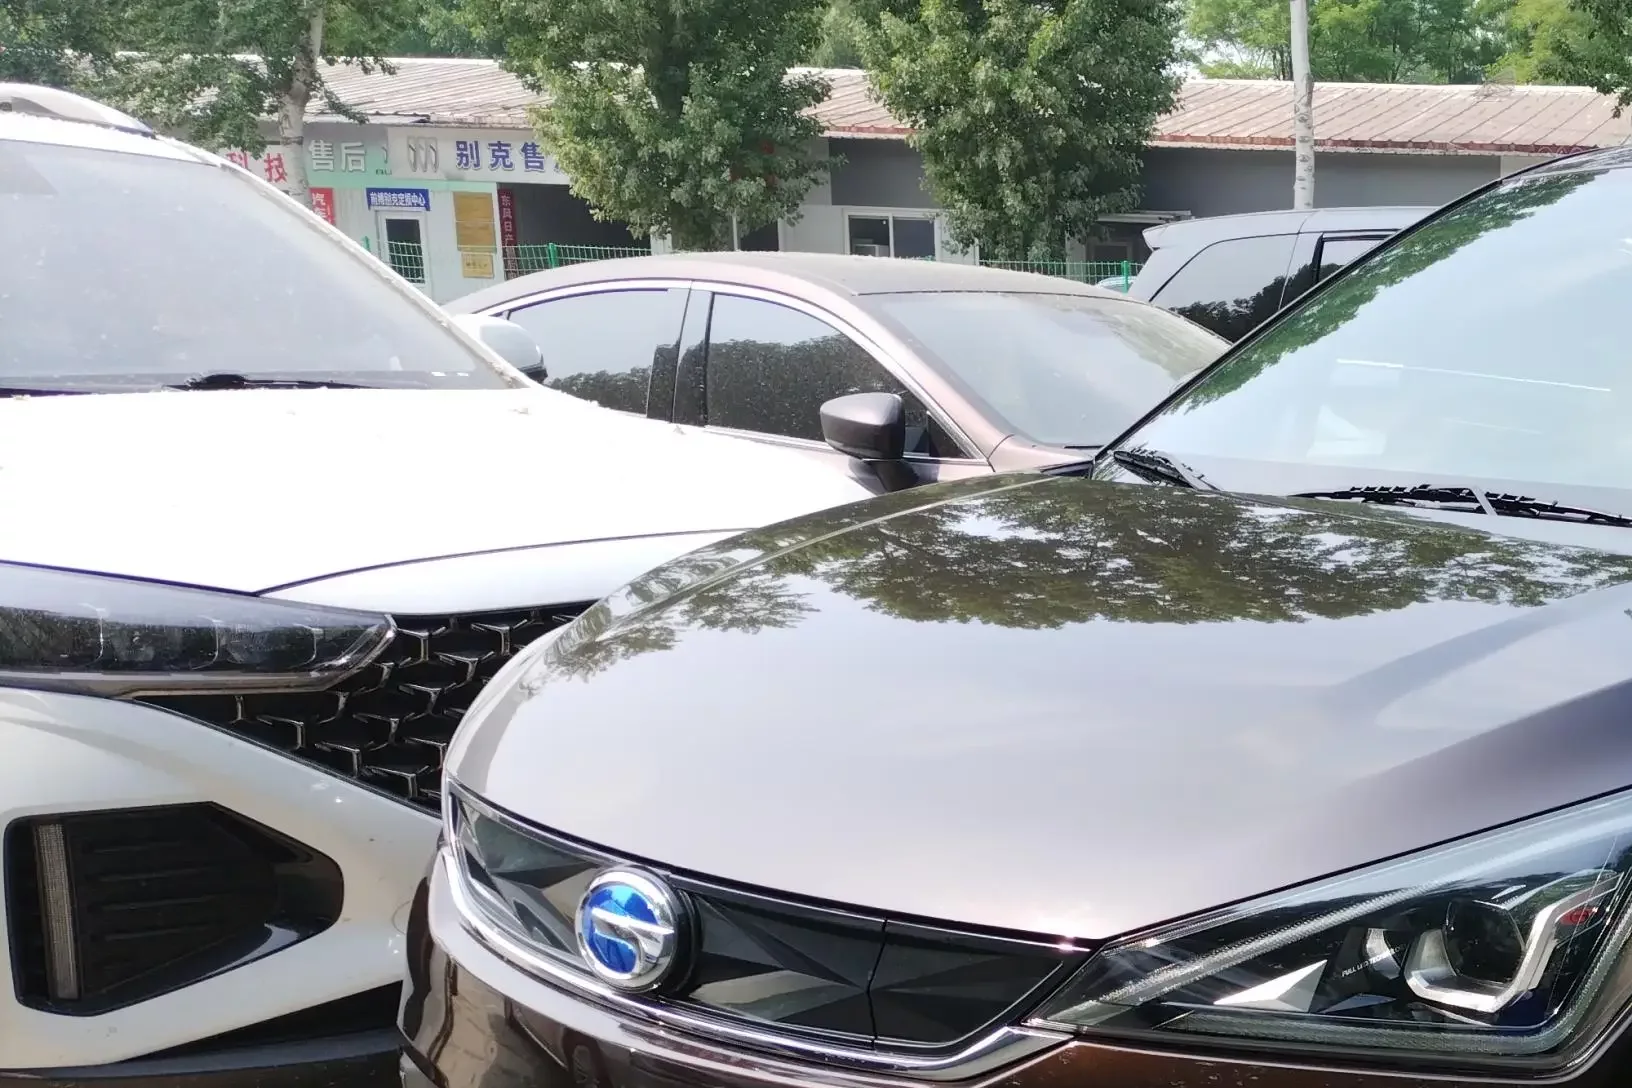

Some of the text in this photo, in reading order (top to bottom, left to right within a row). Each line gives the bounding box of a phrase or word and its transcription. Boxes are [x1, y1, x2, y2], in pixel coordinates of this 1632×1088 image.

[308, 139, 367, 173] 售后
[456, 140, 561, 173] 别克售
